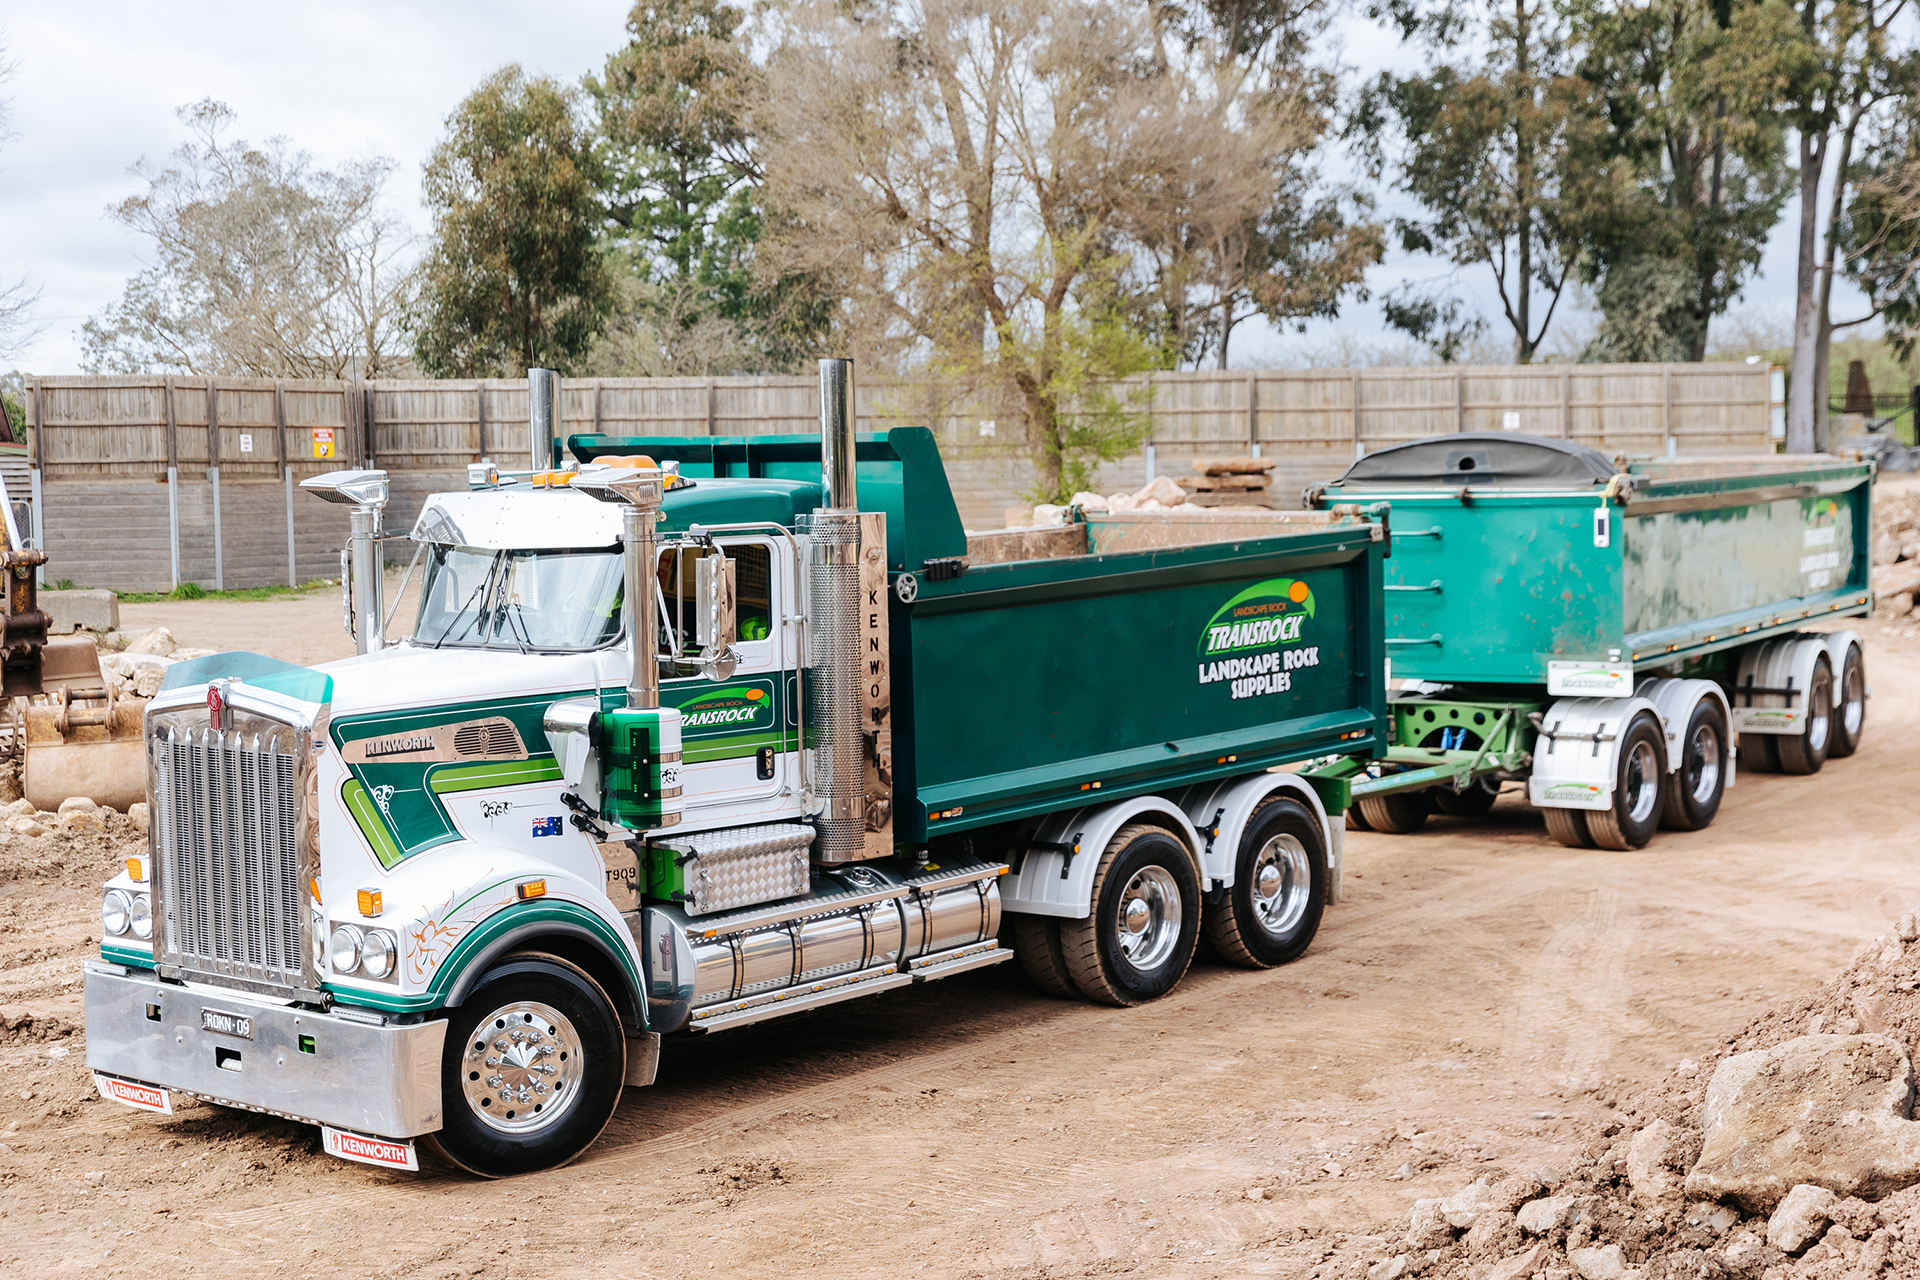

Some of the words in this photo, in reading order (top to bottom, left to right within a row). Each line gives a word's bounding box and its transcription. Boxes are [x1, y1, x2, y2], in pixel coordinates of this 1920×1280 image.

[1233, 604, 1268, 617] LANDSCAPE
[1269, 602, 1287, 613] ROCK
[1206, 614, 1305, 653] TRANSROCK
[1198, 652, 1280, 684] LANDSCAPE
[1282, 646, 1320, 671] ROCK
[869, 590, 881, 769] KENWORTH
[1230, 671, 1291, 700] SUPPLIES
[680, 705, 760, 728] RANSROCK
[692, 702, 725, 711] LANDSCAPE
[365, 735, 435, 758] KENWORTH
[605, 867, 636, 881] T909
[113, 1083, 162, 1106] KENWORTH
[342, 1137, 406, 1162] KENWORTH
